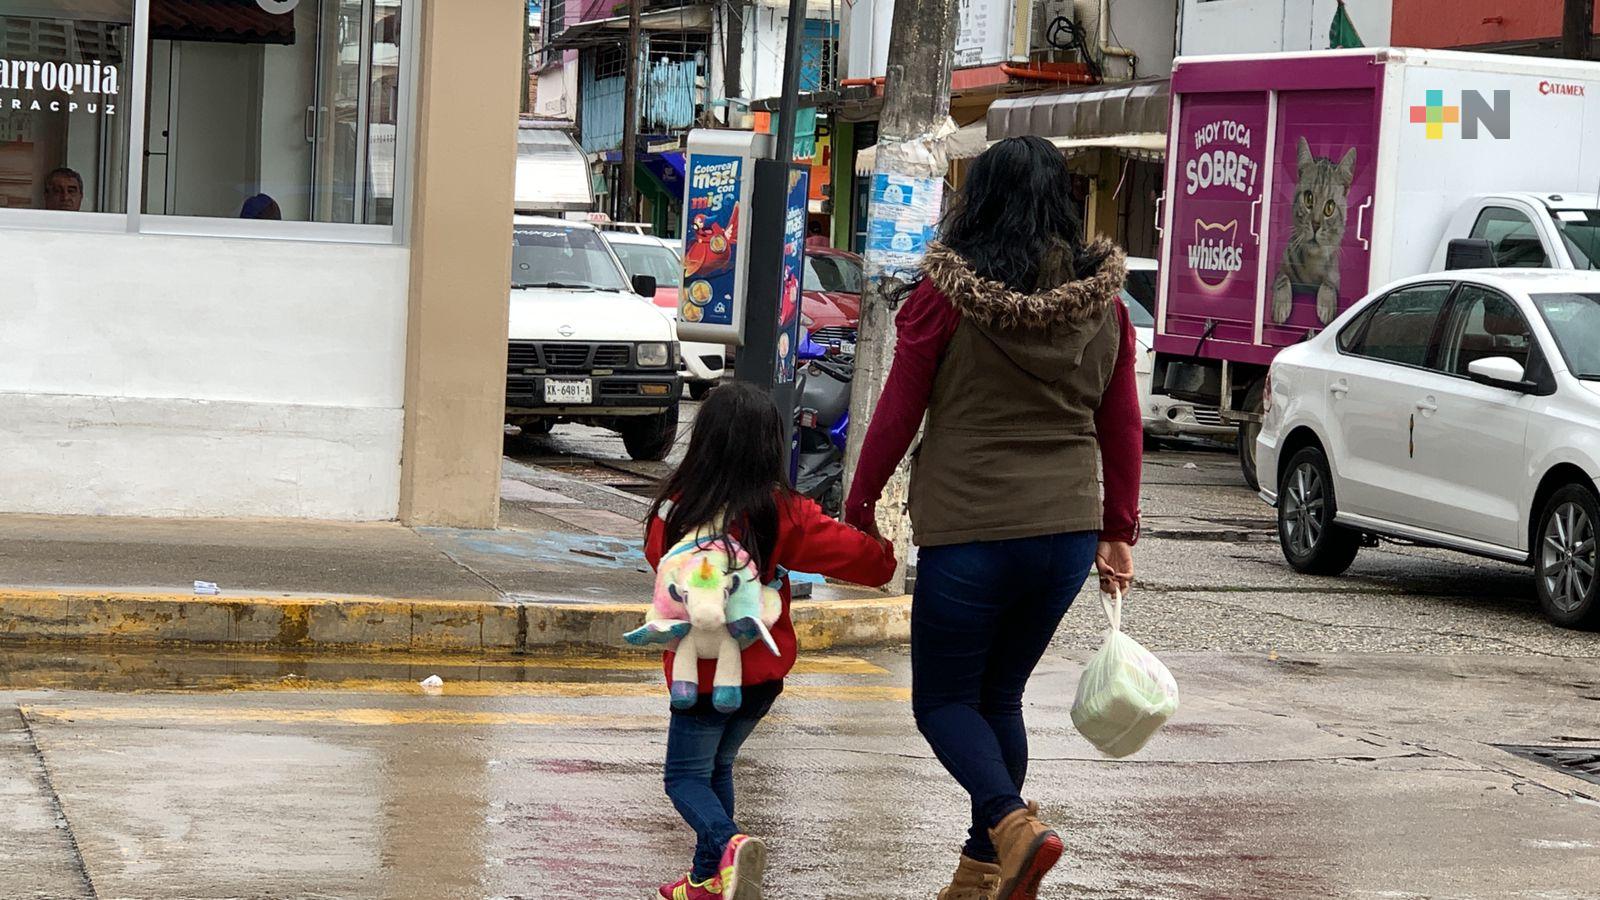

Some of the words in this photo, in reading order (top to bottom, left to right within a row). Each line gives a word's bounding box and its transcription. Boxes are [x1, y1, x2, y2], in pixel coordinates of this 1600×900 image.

[1539, 80, 1586, 97] CATAMEX
[1195, 121, 1220, 150] ¡HOY
[1222, 120, 1250, 149] TOCA
[717, 185, 735, 193] con
[590, 213, 606, 221] TAXI
[1188, 238, 1243, 272] whiskas
[546, 384, 591, 396] XK-6481-A
